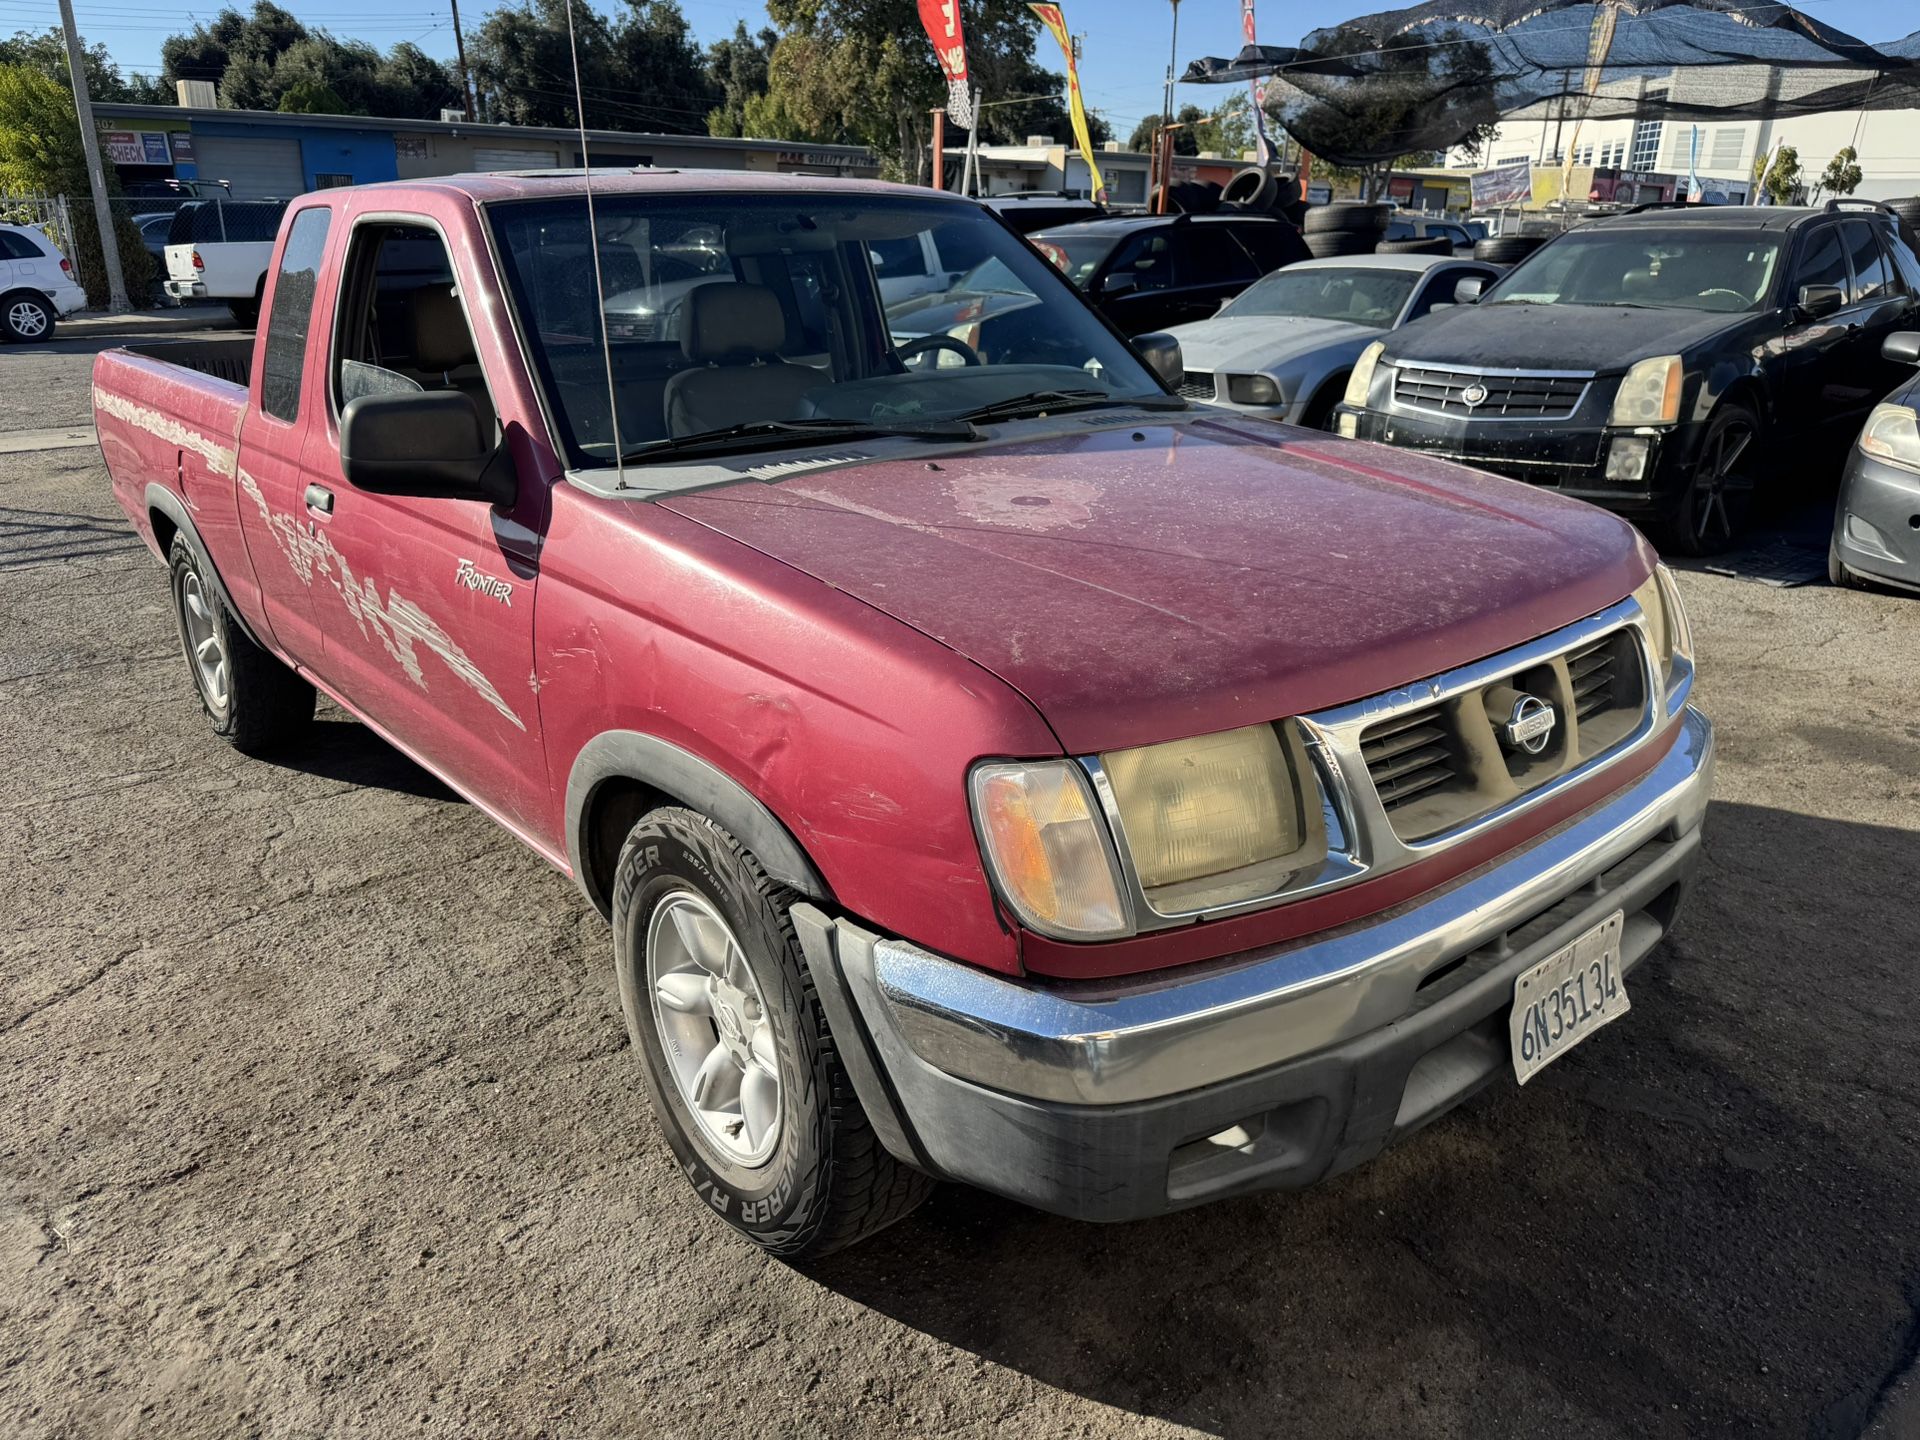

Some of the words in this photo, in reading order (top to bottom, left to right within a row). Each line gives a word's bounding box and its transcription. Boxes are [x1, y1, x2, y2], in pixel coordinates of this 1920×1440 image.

[110, 143, 144, 162] CHECK
[455, 557, 513, 608] FRONTIER
[1518, 712, 1554, 738] NISSAN
[1521, 953, 1617, 1062] 6N35134
[683, 1161, 730, 1214] A/T
